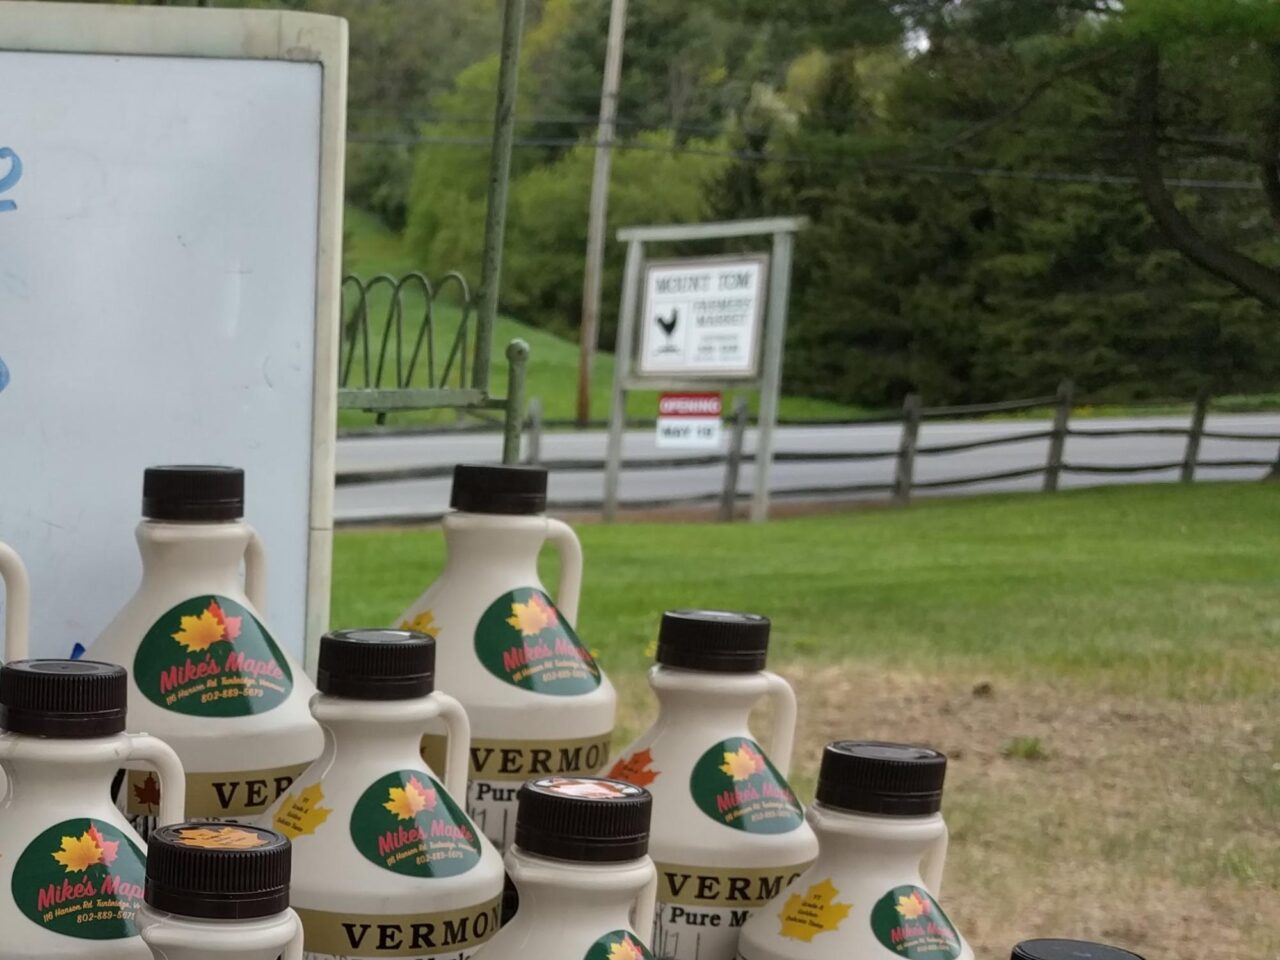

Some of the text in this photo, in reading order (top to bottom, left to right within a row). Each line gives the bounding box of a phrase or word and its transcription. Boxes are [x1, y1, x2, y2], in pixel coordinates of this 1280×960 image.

[160, 651, 284, 694] Mike's Maple
[212, 775, 295, 809] VER
[378, 825, 428, 856] Mike's
[38, 874, 97, 911] Mike's
[55, 903, 82, 918] Hanson
[670, 906, 721, 927] Pure
